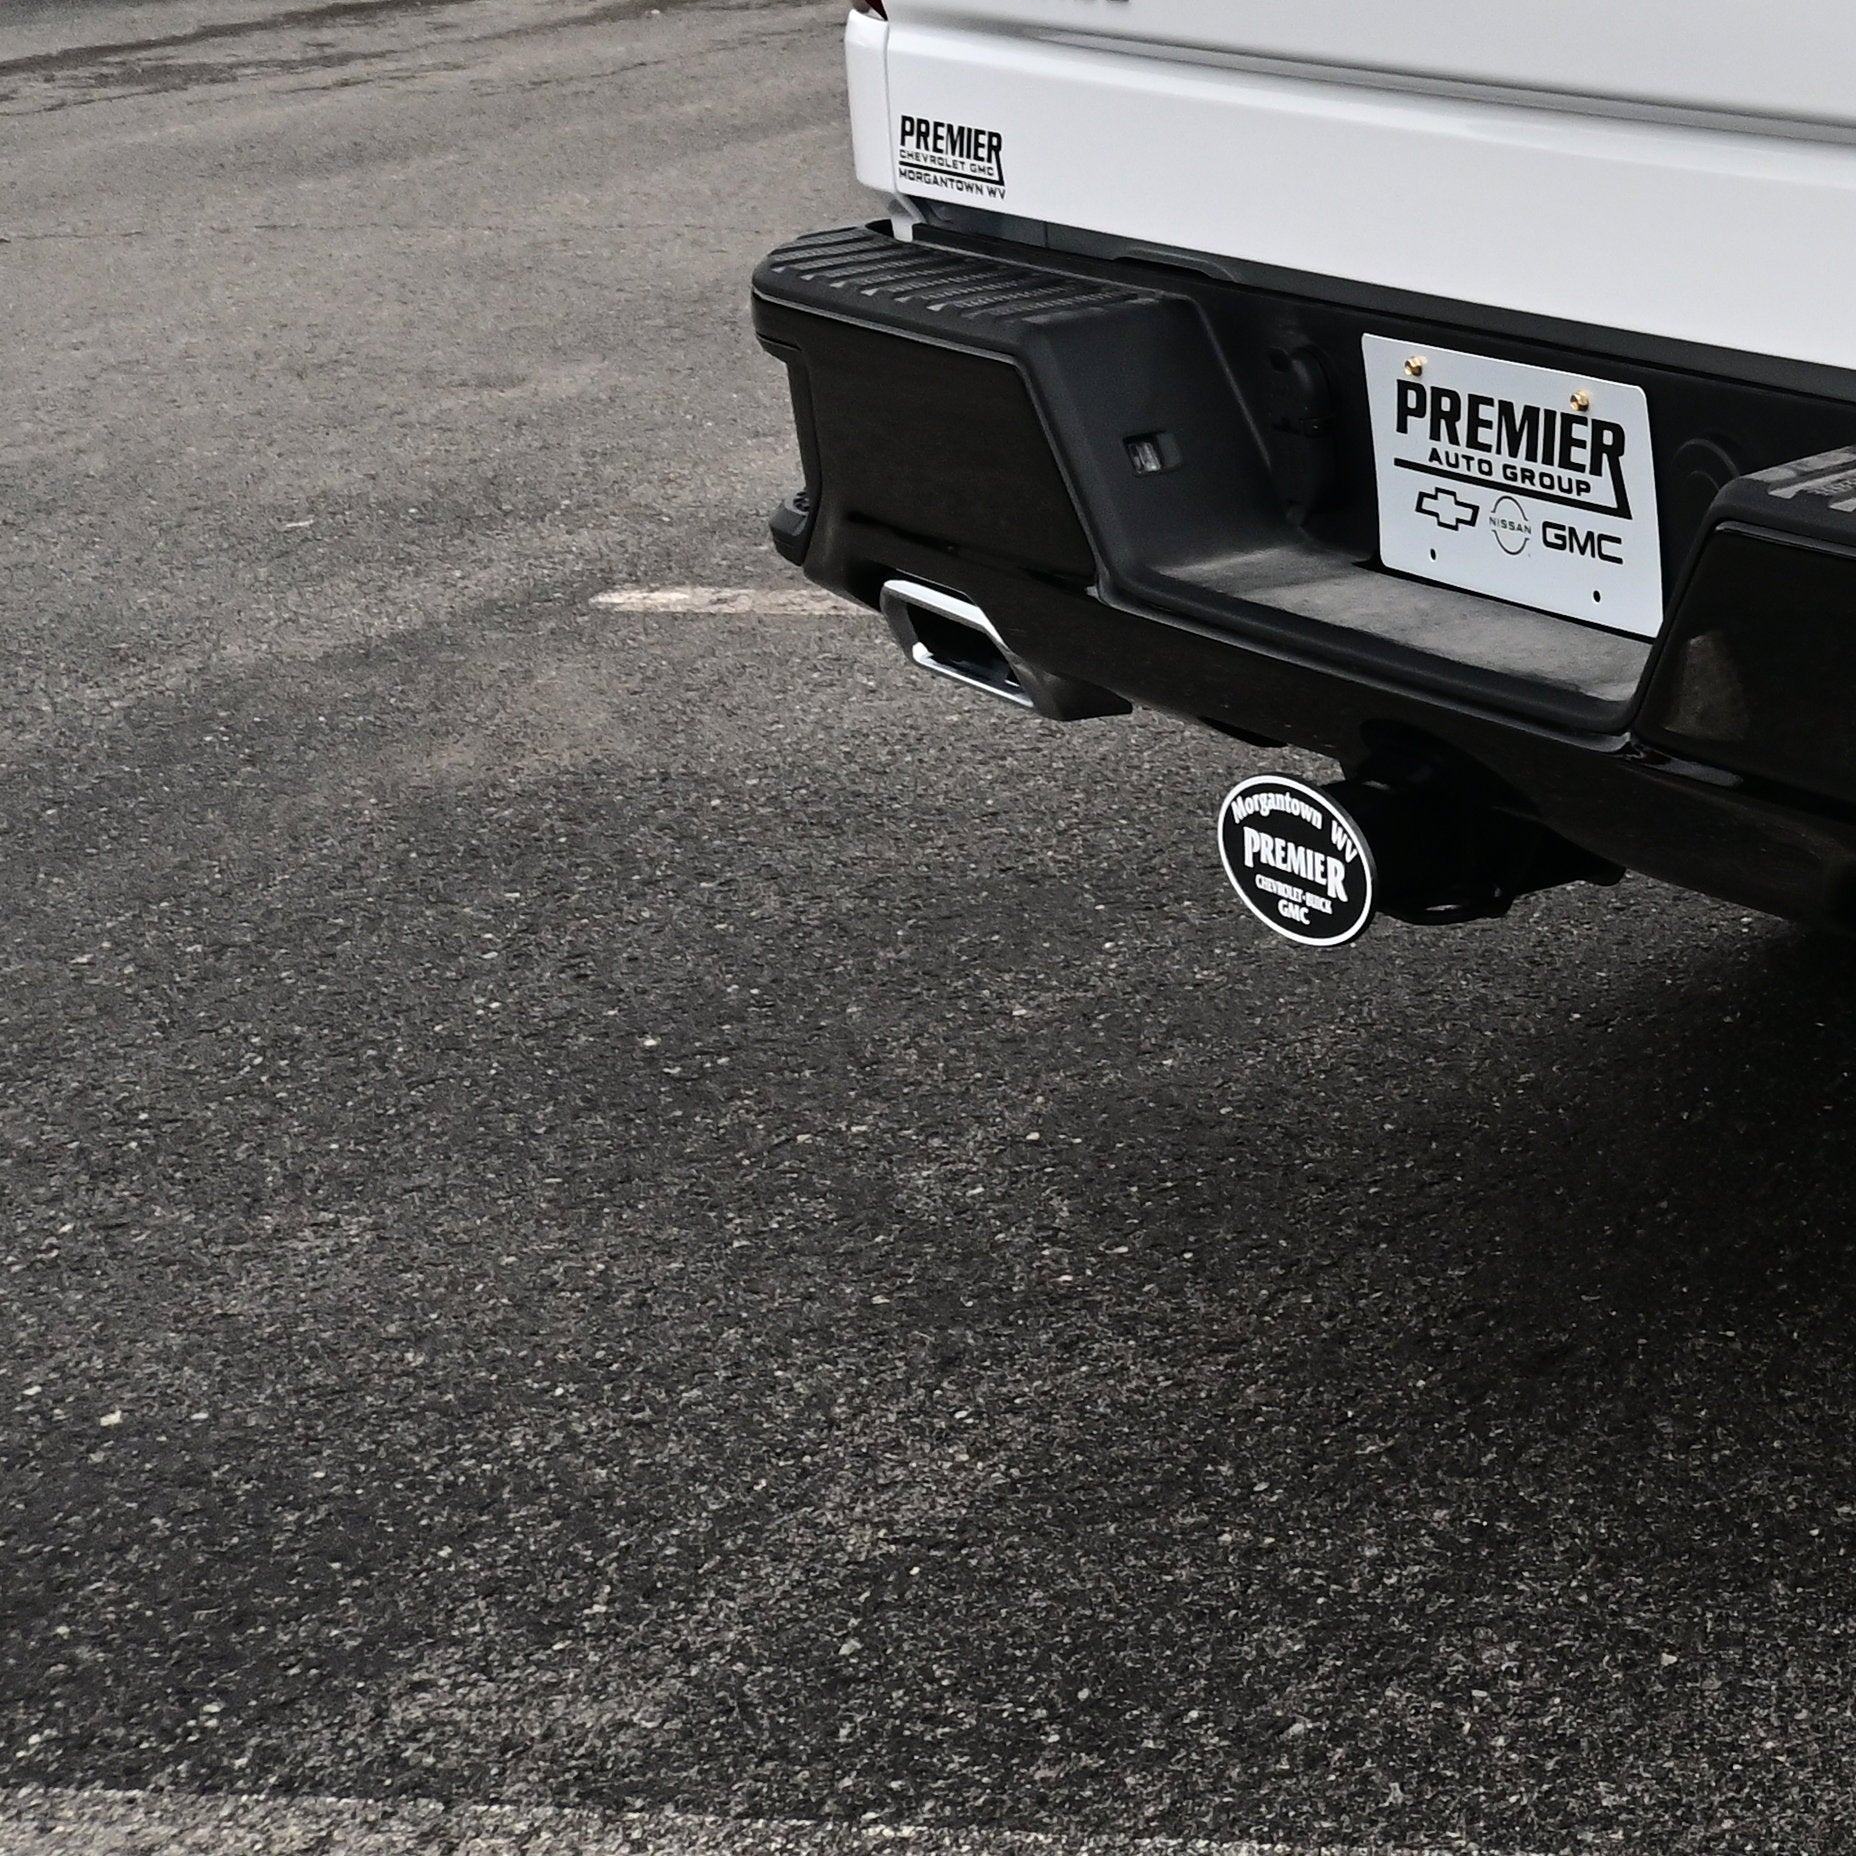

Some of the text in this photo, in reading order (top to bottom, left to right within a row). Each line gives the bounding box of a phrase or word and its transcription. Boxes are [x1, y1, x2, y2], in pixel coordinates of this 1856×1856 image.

[899, 149, 995, 177] CHEVROLET GMC
[900, 114, 1004, 166] PREMIER
[898, 168, 1006, 200] MORGANTOWN WV
[1396, 378, 1626, 480] PREMIER
[1428, 447, 1592, 496] AUTO GROUP
[1488, 516, 1624, 565] NISSAN GMC
[1231, 792, 1358, 863] Morgantown WV
[1243, 826, 1348, 902] PREMIER
[1277, 899, 1310, 925] GMC
